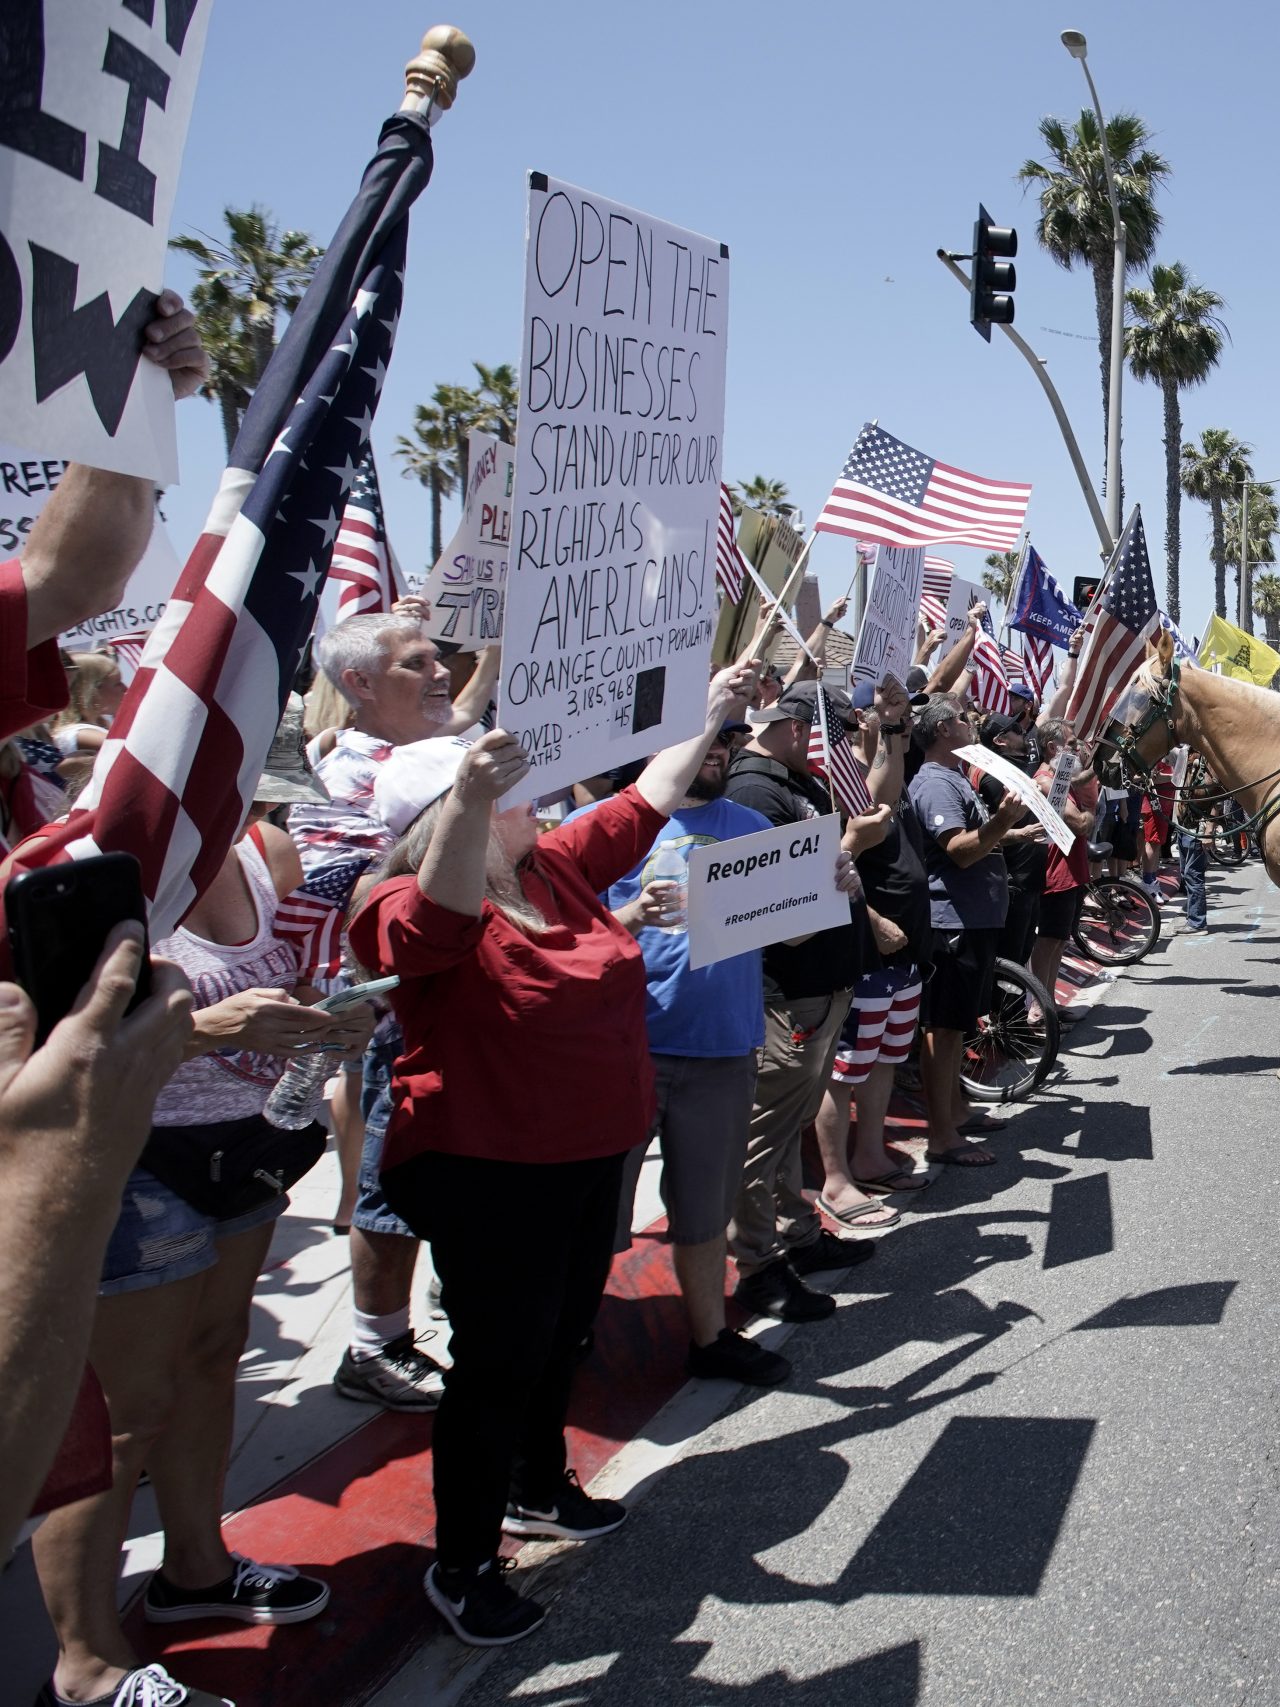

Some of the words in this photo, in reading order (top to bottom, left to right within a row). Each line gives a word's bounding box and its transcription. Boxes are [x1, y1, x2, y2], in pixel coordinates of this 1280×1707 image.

[535, 191, 653, 325] OPEN
[666, 239, 719, 336] THE
[0, 231, 162, 438] W
[527, 316, 701, 422] BUSINESSES
[529, 422, 614, 495] STAND
[618, 430, 647, 487] UP
[648, 432, 681, 486] FOR
[686, 434, 718, 484] OUR
[518, 502, 606, 570] RIGHTS
[608, 501, 643, 553] AS
[477, 559, 494, 578] US
[531, 519, 709, 653] AMERICANS!
[1029, 611, 1053, 627] KEEP
[1053, 622, 1077, 636] AME
[508, 650, 596, 705] ORANGE
[600, 633, 664, 677] COUNTY
[567, 674, 635, 717] 3,185,968
[513, 722, 562, 754] OVID
[615, 703, 633, 728] 45
[527, 746, 562, 768] ATHS
[706, 848, 781, 884] Reopen
[788, 834, 820, 859] CA!
[724, 892, 818, 927] #ReopenCalifornia
[191, 963, 263, 1008] ORN
